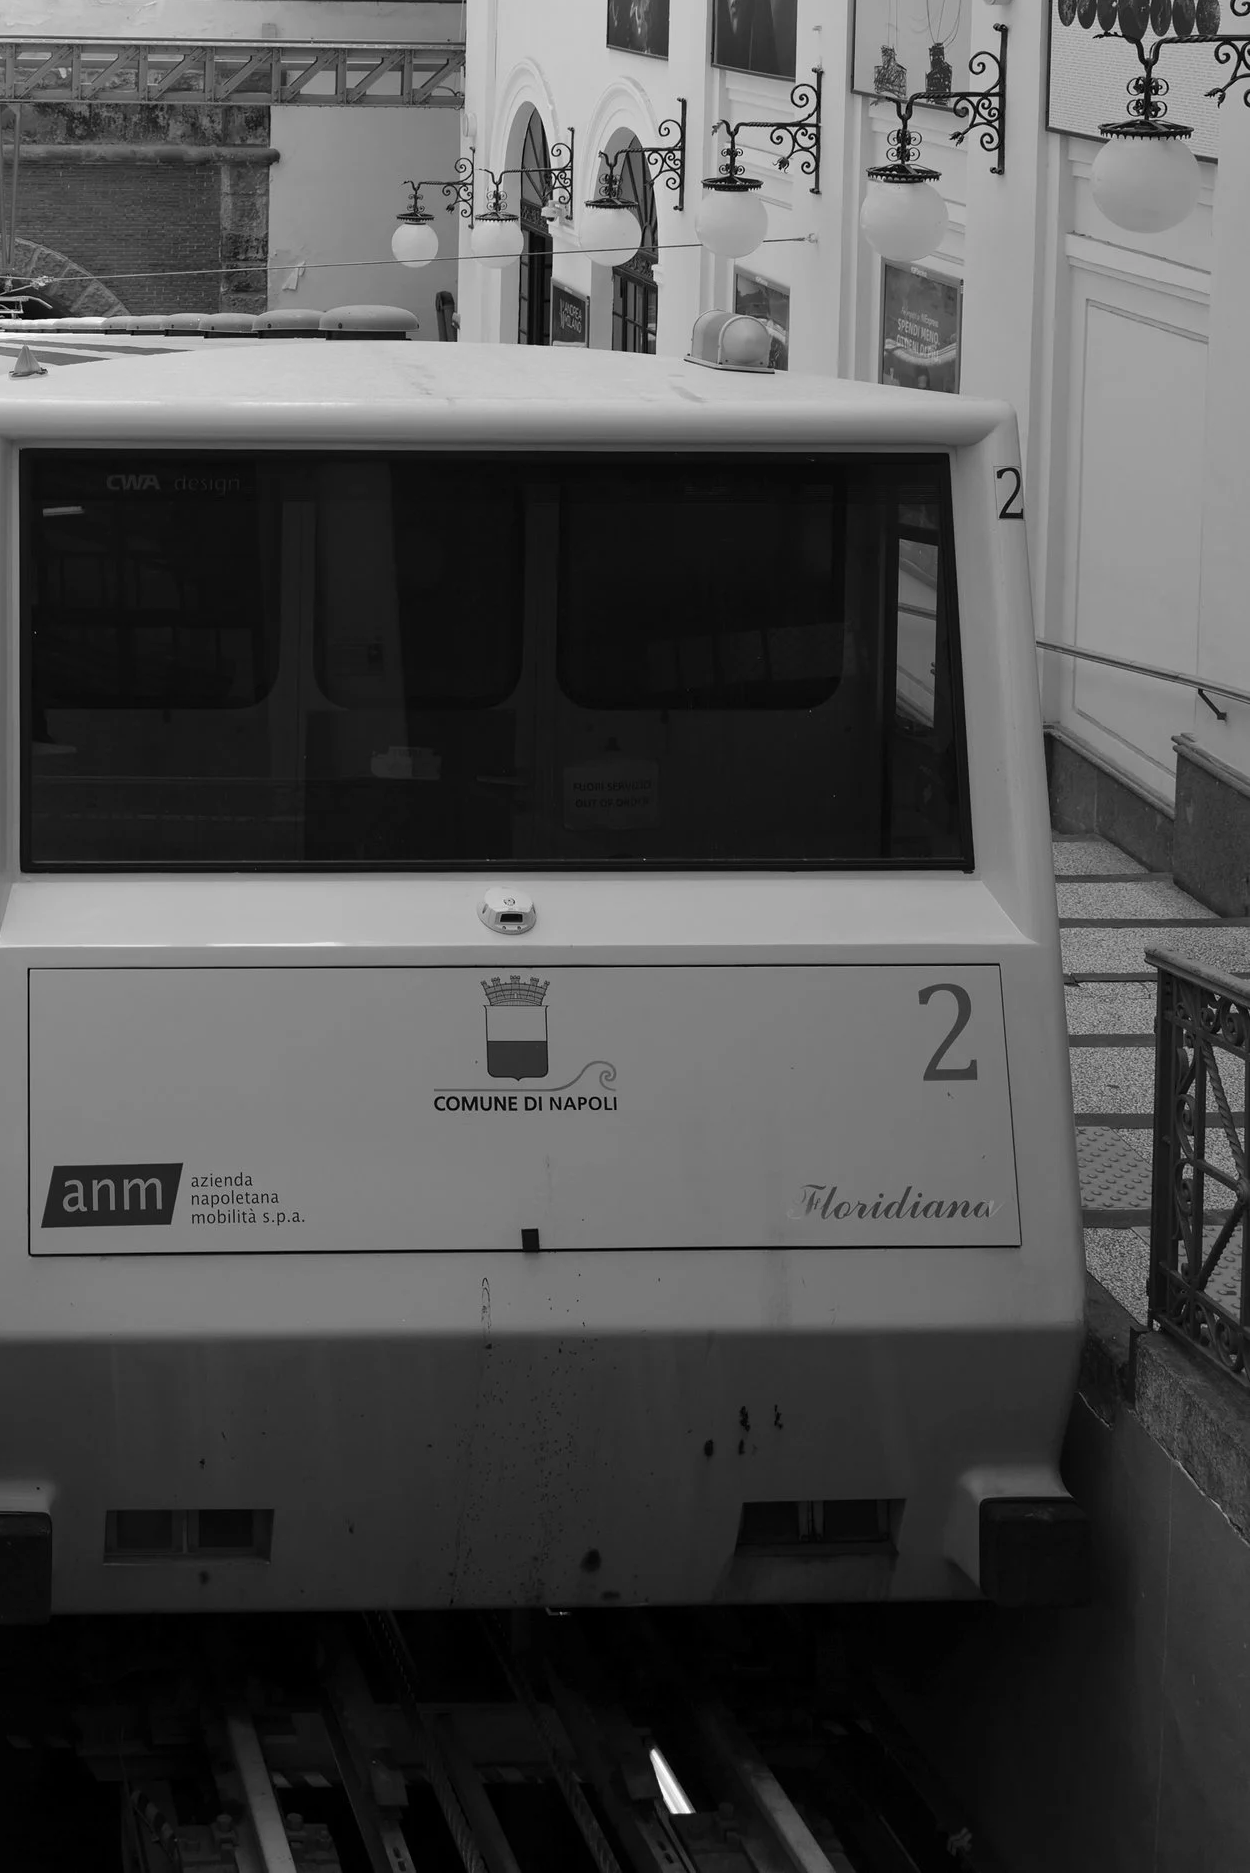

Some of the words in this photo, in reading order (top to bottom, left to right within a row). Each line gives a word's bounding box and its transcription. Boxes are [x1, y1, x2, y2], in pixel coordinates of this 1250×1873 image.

[897, 318, 920, 339] SPENDI
[106, 474, 161, 490] CWA
[174, 474, 240, 496] design
[996, 467, 1024, 519] 2
[575, 797, 597, 808] OUT
[599, 797, 613, 808] OF
[918, 983, 978, 1081] 2
[433, 1095, 518, 1112] COMUNE
[524, 1095, 543, 1112] DI
[549, 1095, 617, 1112] NAPOLI
[191, 1172, 253, 1187] azienda
[62, 1177, 163, 1213] anm
[191, 1190, 279, 1208] napoletana
[795, 1184, 999, 1220] Floridiana
[191, 1209, 256, 1225] mobilità
[262, 1212, 305, 1227] s.p.a.
